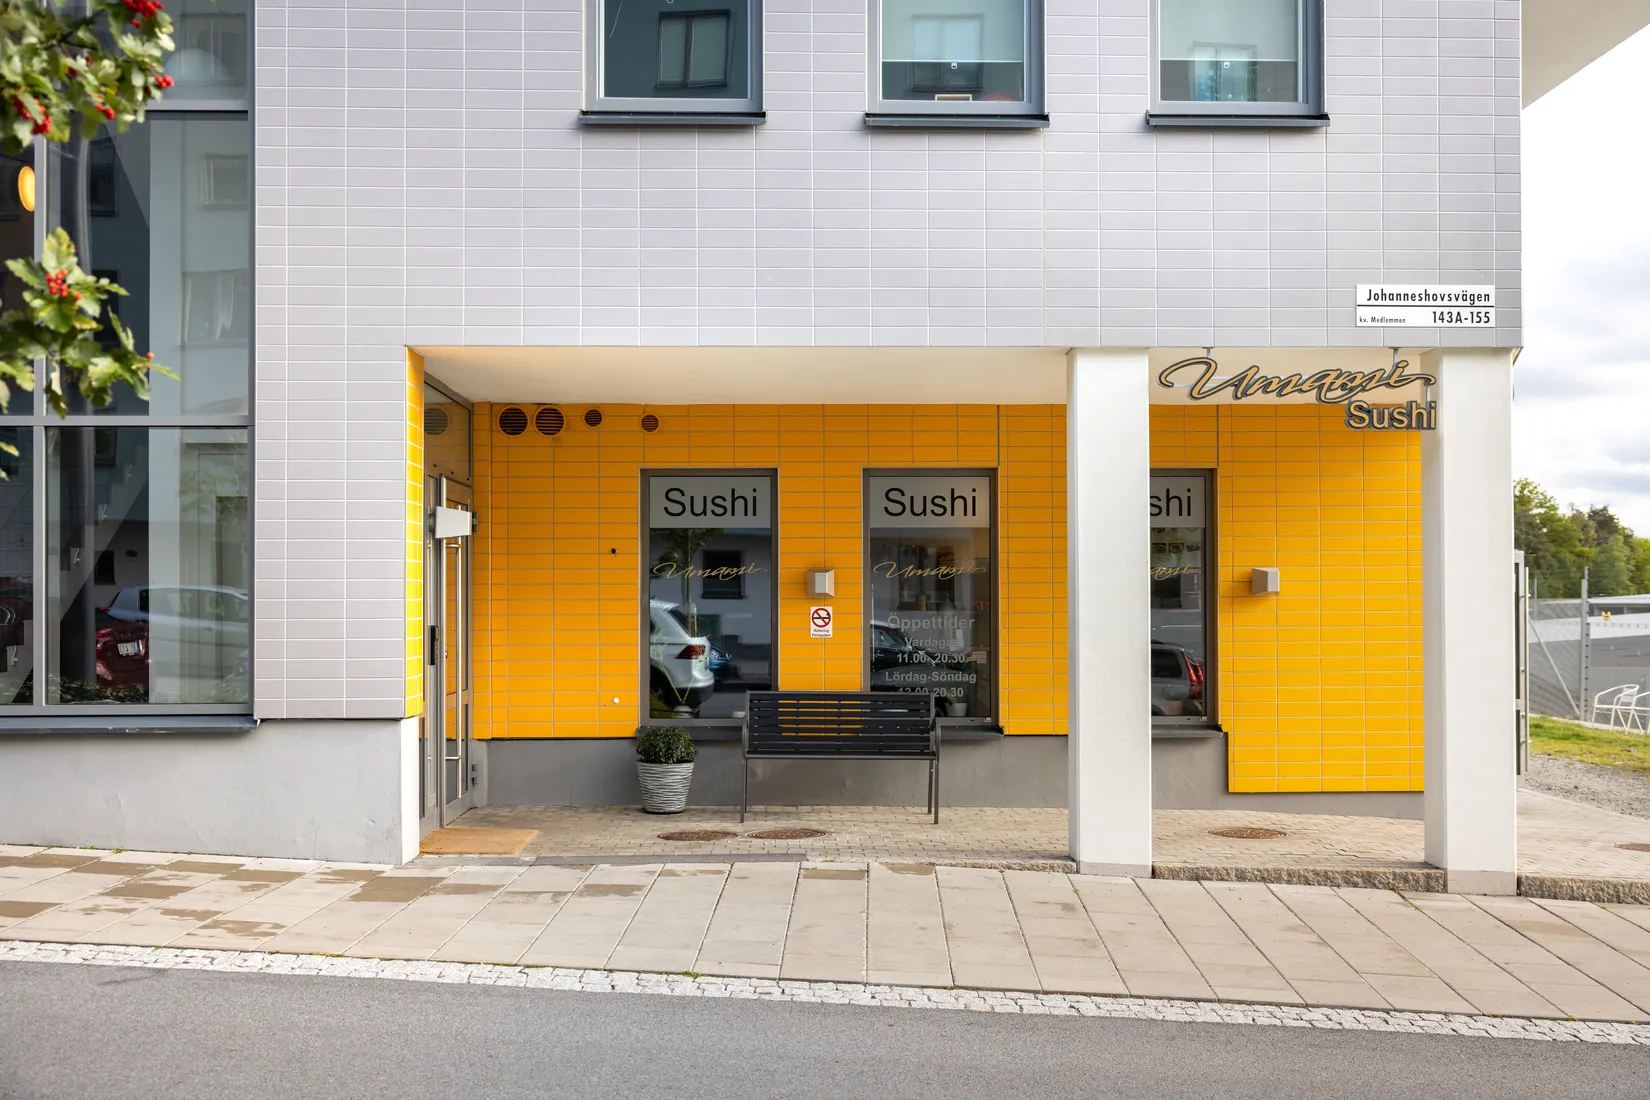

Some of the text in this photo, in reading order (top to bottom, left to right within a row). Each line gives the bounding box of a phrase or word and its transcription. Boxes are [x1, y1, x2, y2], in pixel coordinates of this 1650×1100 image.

[1367, 288, 1490, 305] Johanneshovsvägen
[1371, 316, 1406, 324] Medlemmen
[1432, 310, 1491, 324] 143A-155
[1157, 356, 1437, 404] Umami
[1345, 400, 1437, 430] Sushi
[663, 487, 757, 517] Sushi
[883, 487, 977, 517] Sushi
[1150, 488, 1191, 517] shi
[653, 561, 768, 581] Umami
[887, 612, 976, 632] Öppettider
[934, 653, 966, 663] 20.30
[885, 671, 977, 684] Lördag-Söndag
[933, 687, 964, 698] 20.30
